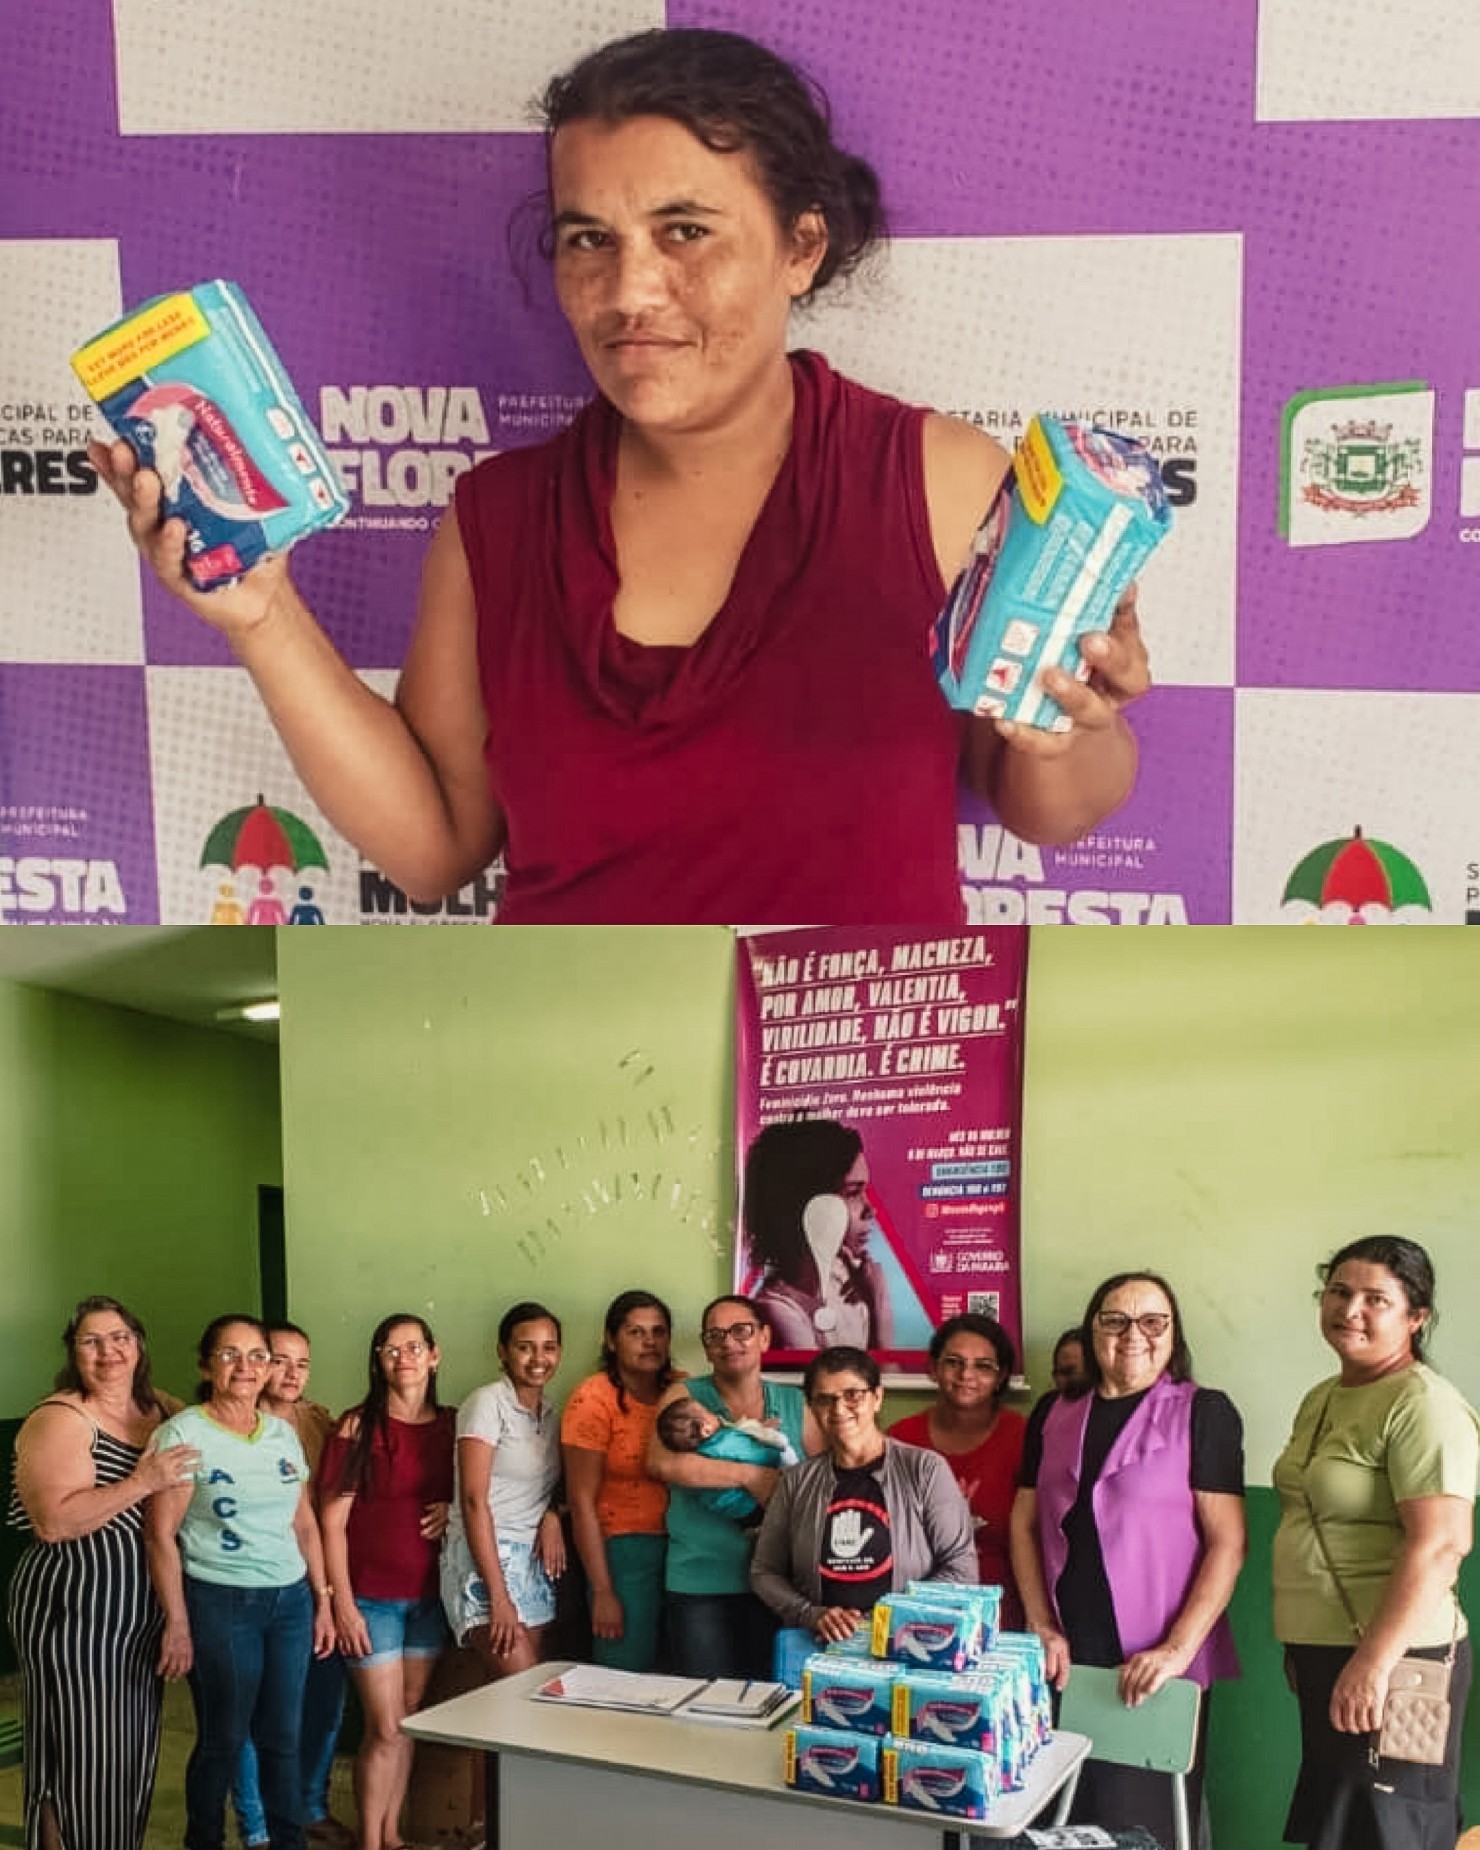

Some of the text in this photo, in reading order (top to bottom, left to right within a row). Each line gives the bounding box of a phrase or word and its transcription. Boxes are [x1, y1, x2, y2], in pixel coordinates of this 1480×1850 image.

[67, 404, 94, 421] DE
[320, 385, 491, 444] NOVA
[947, 410, 1198, 428] TARIA ICIPAL DE
[332, 449, 502, 508] FLOR
[335, 516, 429, 530] ONTINUANDO
[1054, 852, 1145, 869] MUNICIPAL
[1069, 835, 1156, 851] EFEITURA
[360, 870, 508, 917] MLH
[803, 951, 816, 982] É
[818, 948, 886, 980] FORÇA,
[761, 974, 967, 1020] POR AMOR, VALENTIA,
[761, 1018, 867, 1052] VIRILIDADE,
[873, 1009, 915, 1040] NÃO
[919, 1005, 931, 1037] É
[760, 1043, 966, 1087] É COVARDIA. É CRIME.
